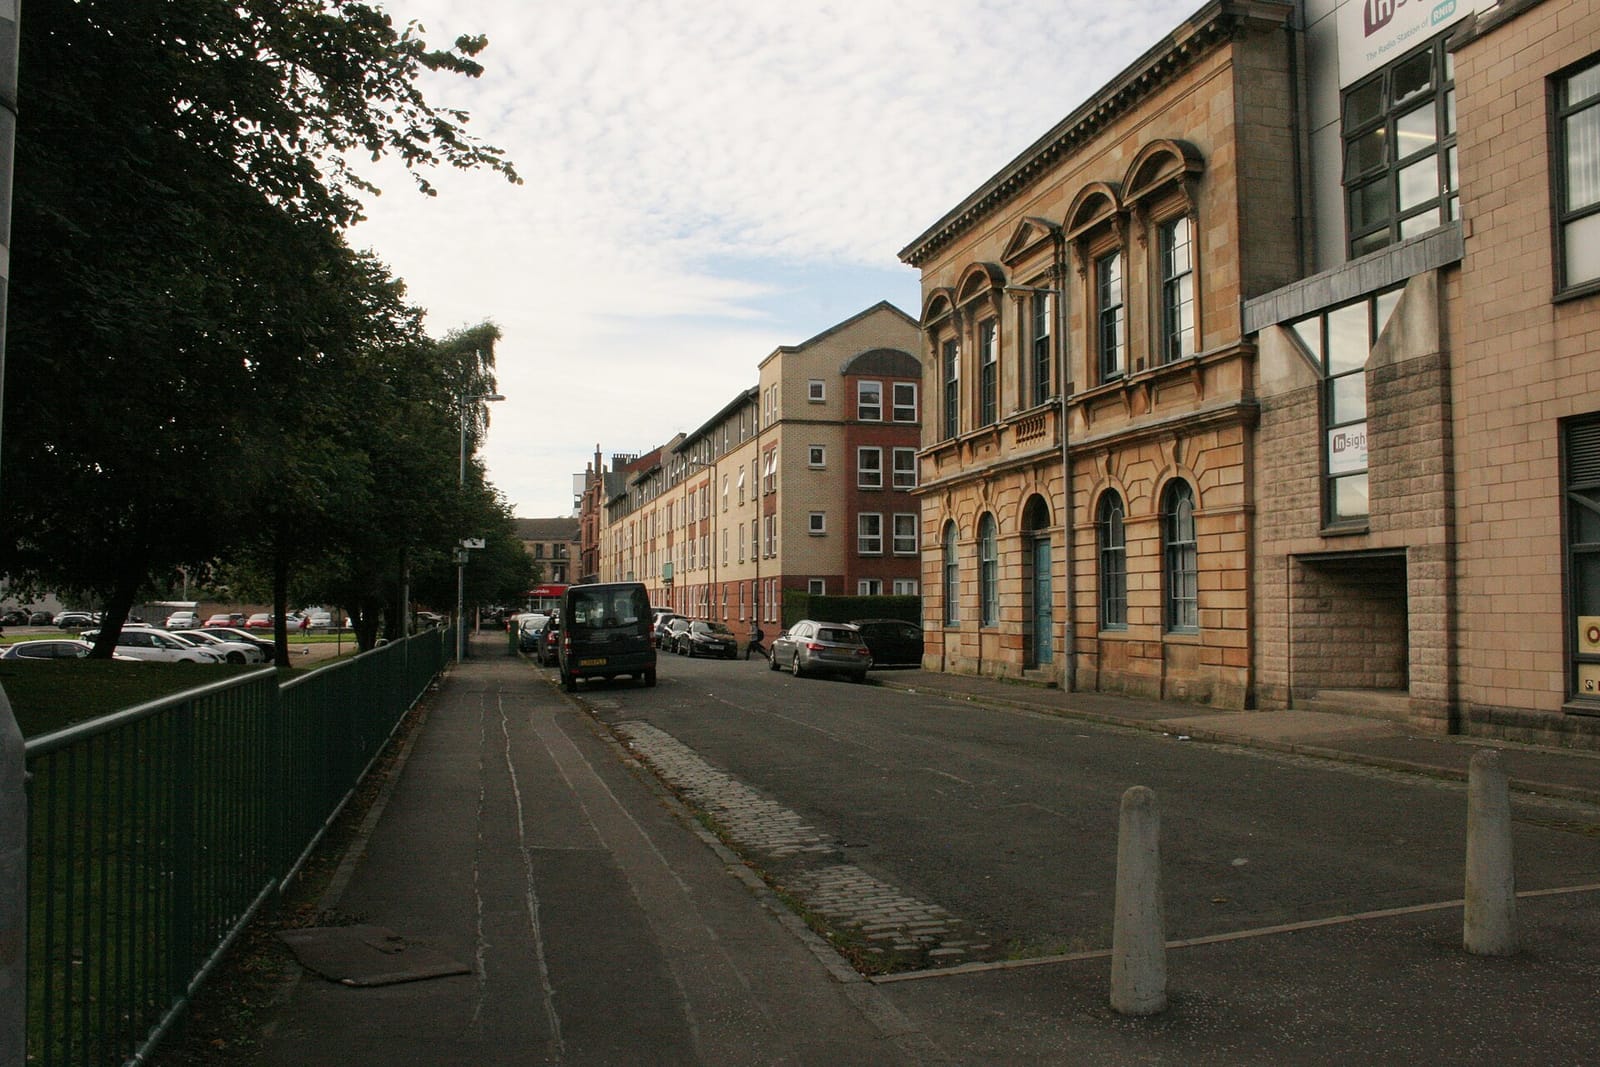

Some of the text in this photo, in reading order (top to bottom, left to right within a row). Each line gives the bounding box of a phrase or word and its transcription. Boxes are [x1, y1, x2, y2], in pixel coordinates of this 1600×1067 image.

[1433, 1, 1455, 22] RNIB
[1366, 16, 1429, 60] The Radio Station of
[1334, 432, 1367, 453] Insigh
